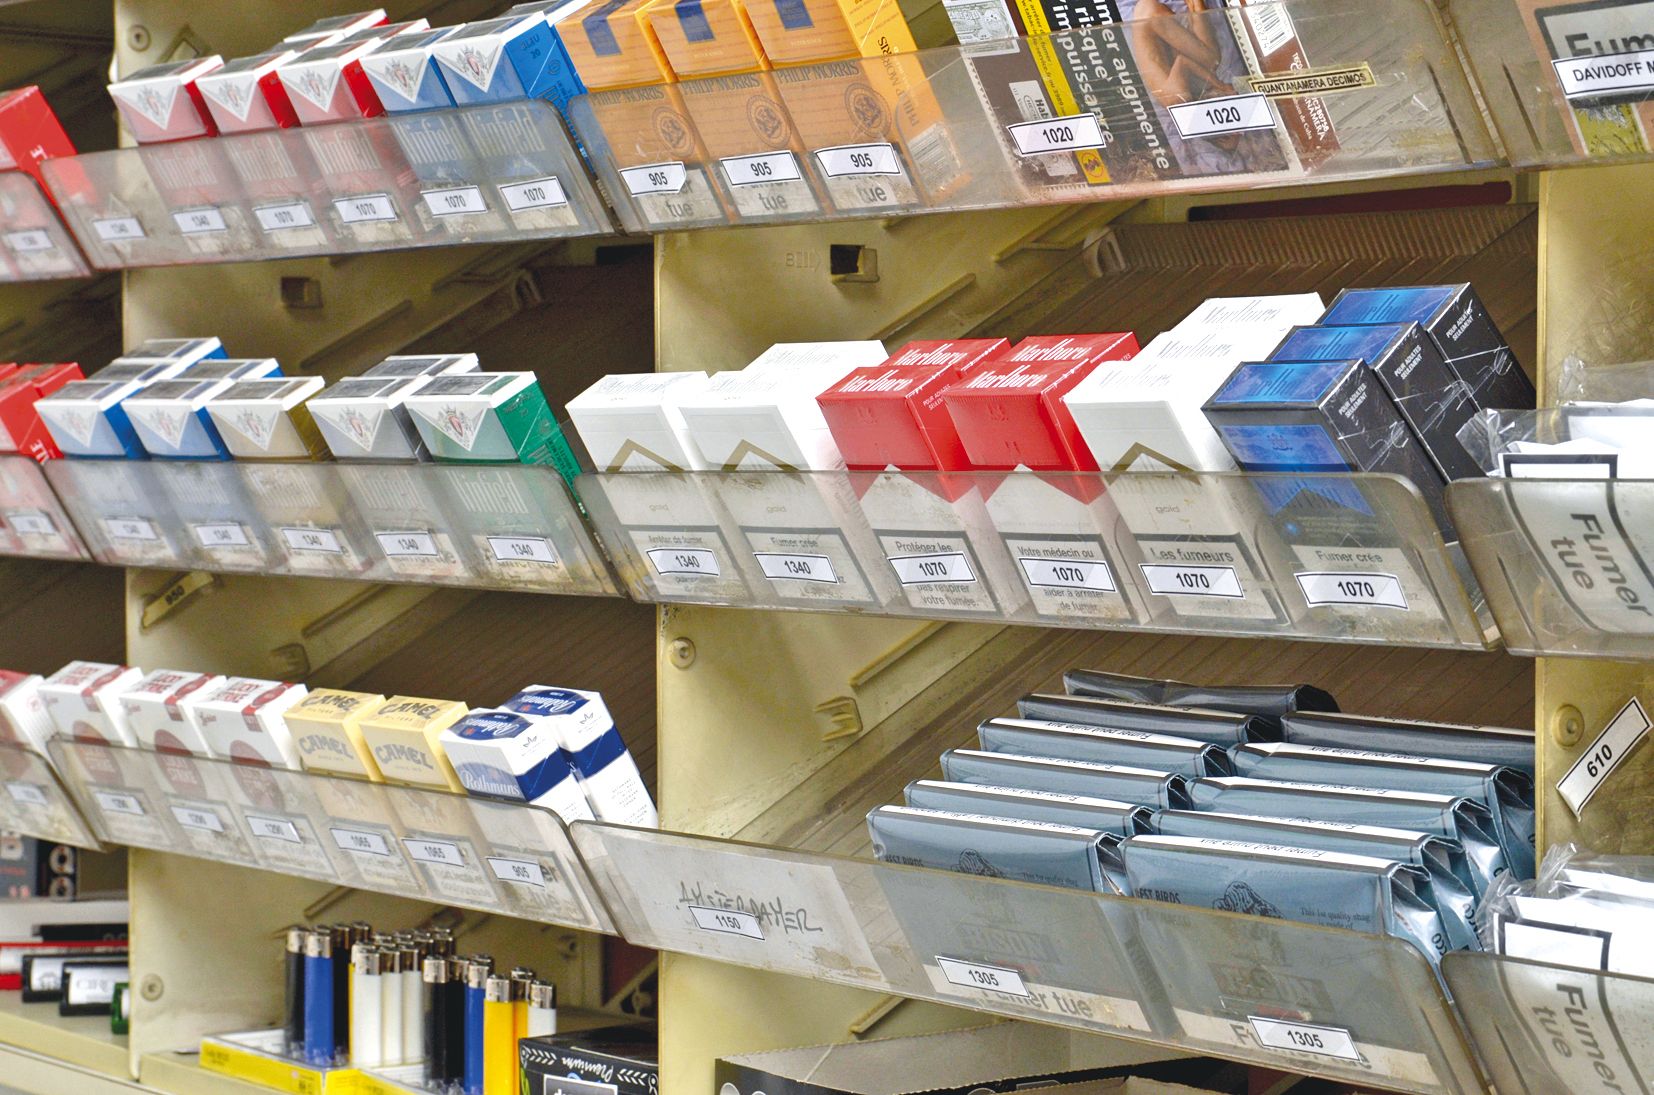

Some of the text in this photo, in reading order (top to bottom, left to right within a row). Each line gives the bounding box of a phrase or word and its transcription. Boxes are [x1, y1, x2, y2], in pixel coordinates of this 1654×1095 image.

[1074, 6, 1108, 80] risque
[776, 60, 860, 84] PHILIP MORRIS
[1573, 61, 1642, 82] DAVIDOFF
[681, 72, 761, 95] PHILIP MORRIS
[1257, 72, 1367, 94] GUANTANAMERA DECIMOS
[1112, 57, 1170, 170] augmente
[1206, 106, 1241, 125] 1020
[461, 104, 546, 158] Winfield
[1042, 126, 1074, 144] 1020
[750, 162, 772, 176] 905
[850, 153, 873, 168] 905
[649, 173, 668, 186] 905
[445, 194, 466, 208] 1070
[523, 187, 546, 201] 1070
[758, 193, 788, 211] tue
[356, 202, 377, 216] 1070
[666, 200, 694, 217] tue
[1445, 322, 1458, 339] POUR
[1452, 316, 1474, 341] SEULEMENT
[894, 342, 968, 366] Marlboro
[1010, 337, 1092, 362] Marlboro
[965, 364, 1048, 389] Marlboro
[1394, 361, 1406, 377] POUR
[1400, 355, 1422, 380] SEULEMENT
[838, 369, 914, 393] Marlboro
[446, 468, 530, 514] Winfield
[397, 537, 419, 551] 1340
[510, 543, 534, 557] 1340
[938, 542, 953, 551] les
[1017, 546, 1095, 558] Votre médecin ou
[675, 555, 700, 568] 1340
[1150, 547, 1234, 562] Les fumeurs
[1315, 550, 1384, 563] Fumer crée
[1550, 536, 1595, 591] tue
[784, 560, 811, 574] 1340
[919, 561, 948, 577] 1070
[1570, 511, 1653, 618] Fumer
[1052, 566, 1084, 582] 1070
[1176, 572, 1210, 588] 1070
[1338, 581, 1375, 597] 1070
[921, 596, 945, 605] votre
[300, 694, 360, 712] CAMEL
[377, 702, 440, 720] CAMEL
[299, 734, 354, 761] CAMEL
[374, 743, 434, 770] CAMEL
[1587, 743, 1613, 779] 610
[463, 770, 521, 796] Rothmans
[424, 845, 446, 859] 1065
[512, 865, 530, 879] 905
[1301, 907, 1314, 916] This
[715, 914, 741, 929] 1150
[968, 968, 999, 986] 1305
[1052, 990, 1094, 1019] tue
[1286, 1028, 1324, 1050] 1305
[1532, 1006, 1573, 1058] tue
[1555, 982, 1625, 1095] Fumer
[562, 1056, 614, 1083] Premium
